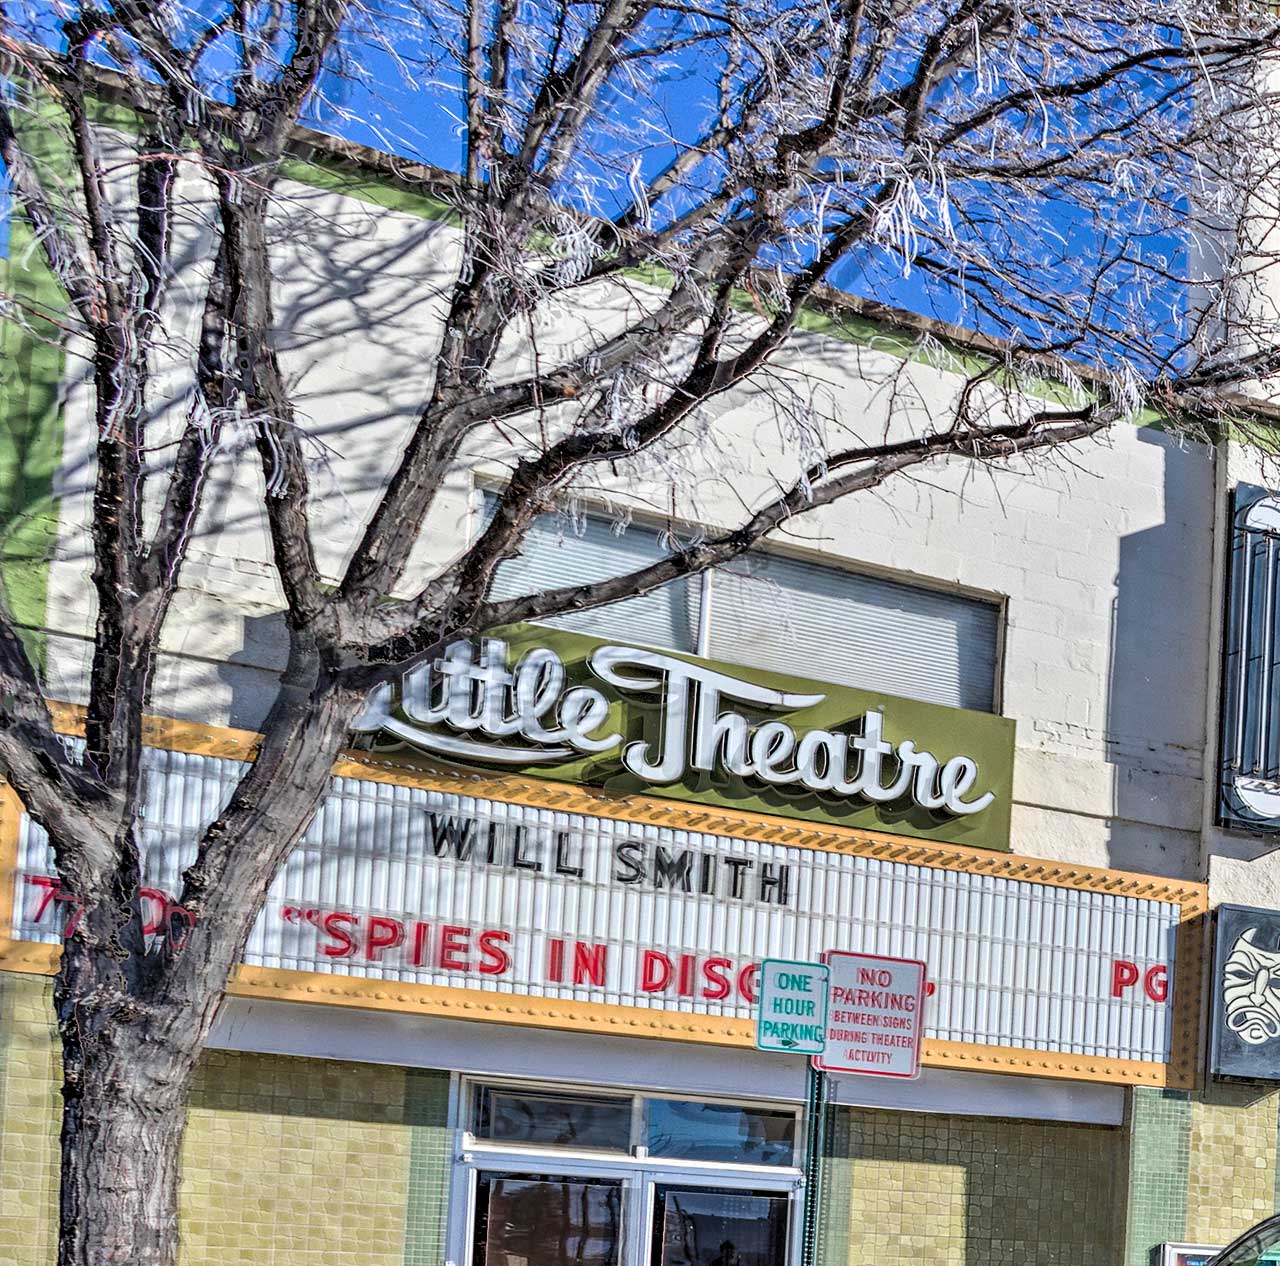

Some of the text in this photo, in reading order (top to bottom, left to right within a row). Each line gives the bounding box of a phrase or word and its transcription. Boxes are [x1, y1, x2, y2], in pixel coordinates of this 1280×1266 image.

[588, 645, 996, 815] Theatre
[424, 811, 790, 905] WILL SMITH
[549, 939, 608, 987] IN
[778, 972, 813, 993] ONE
[856, 968, 893, 988] NO
[1112, 959, 1169, 1003] PG
[773, 997, 816, 1018] HOUR
[832, 986, 916, 1012] PARKING
[832, 1010, 912, 1031] BETWEEN SIGNS
[762, 1021, 825, 1044] PARKING
[829, 1028, 913, 1049] DURING THEATER
[845, 1048, 893, 1065] ACTIVITY
